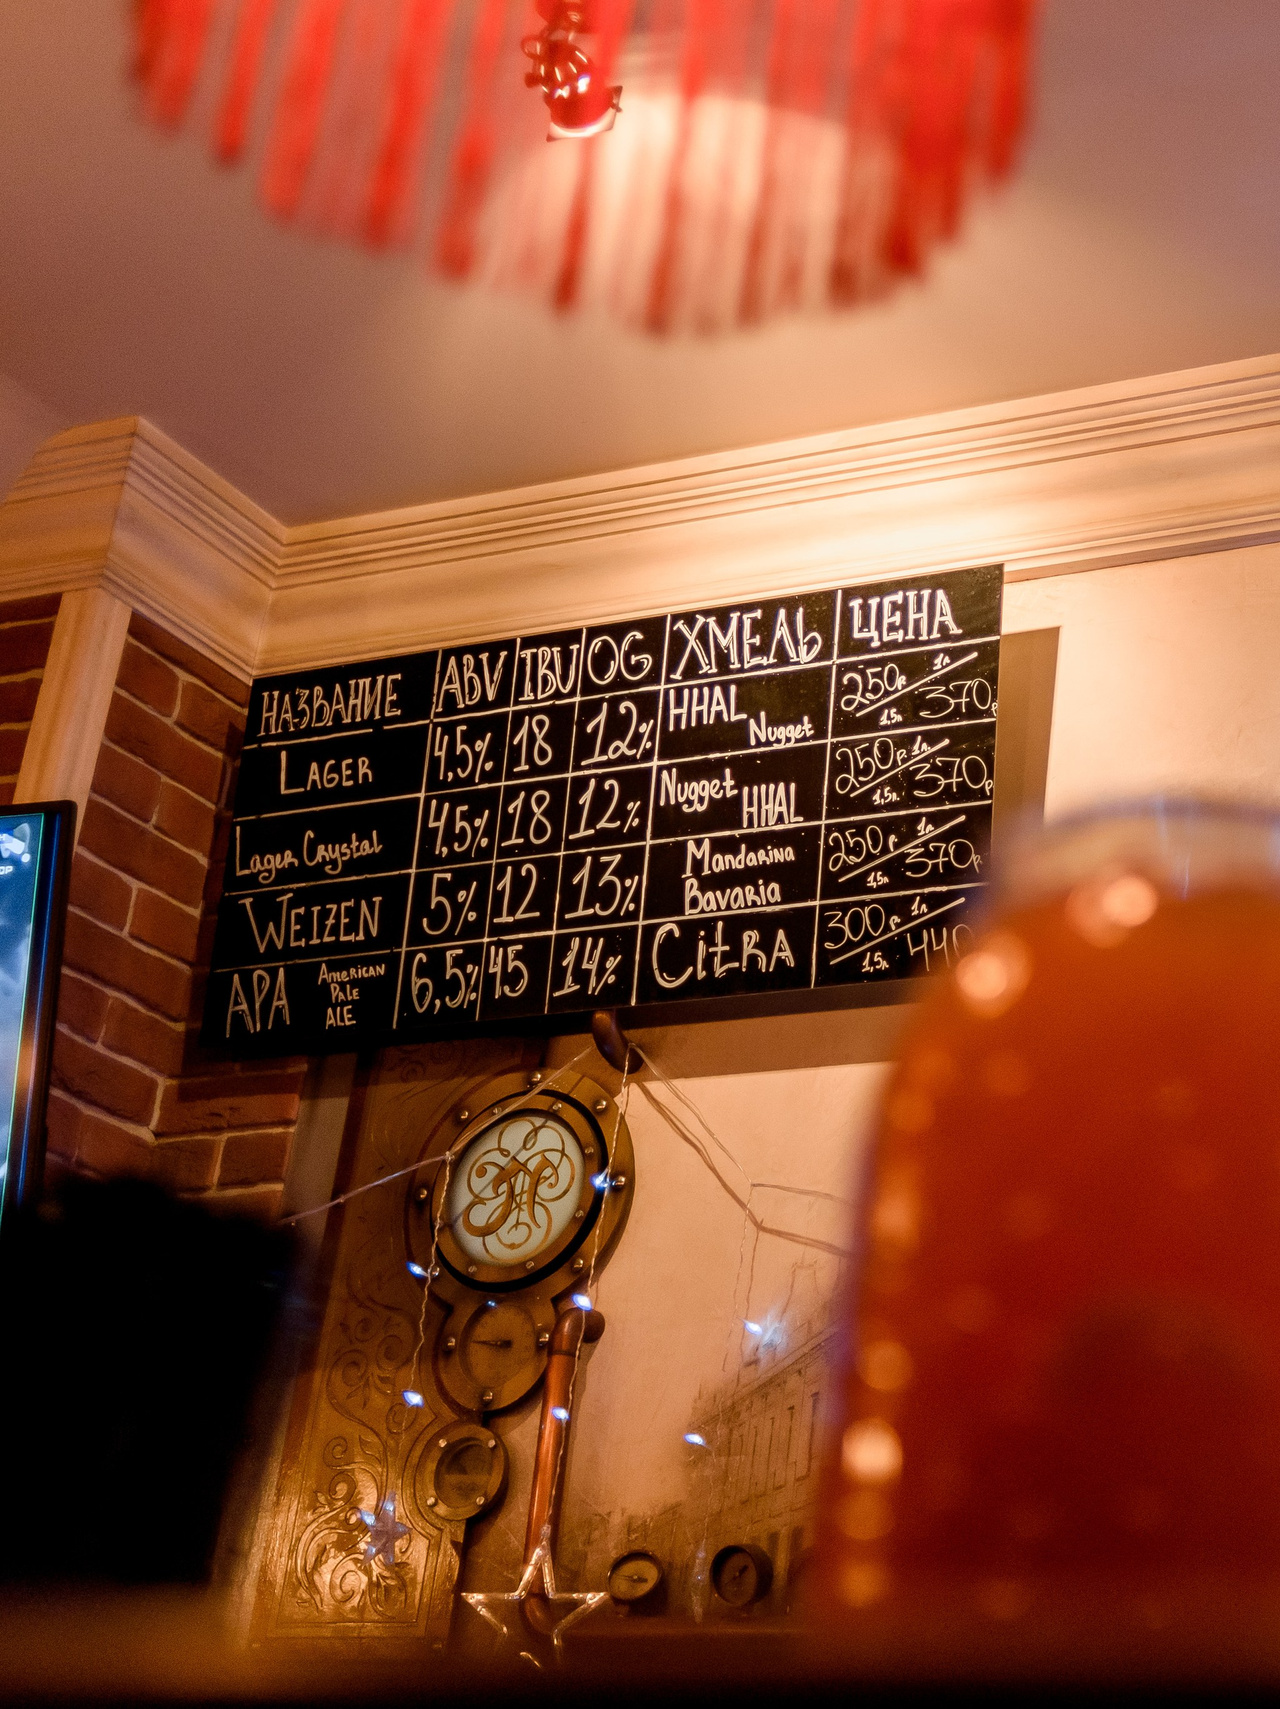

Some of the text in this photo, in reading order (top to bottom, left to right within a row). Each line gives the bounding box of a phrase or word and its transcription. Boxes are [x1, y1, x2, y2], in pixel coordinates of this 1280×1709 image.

[669, 606, 822, 680] ХМЕЛЬ
[849, 588, 963, 648] ЦЕНА
[435, 650, 508, 712] ABV
[518, 643, 581, 701] IBU
[586, 631, 653, 685] OG
[256, 673, 403, 737] НАЗВАНИЕ
[580, 700, 655, 766] 12%
[749, 712, 814, 748] Nugget
[512, 713, 553, 773] 18
[502, 789, 552, 847] 18
[568, 778, 640, 840] 12%
[659, 767, 738, 812] Nugget
[422, 872, 478, 936] 5%
[493, 862, 541, 924] 12
[564, 853, 639, 920] 13%
[489, 944, 529, 999] 45
[552, 937, 622, 998] 14%
[226, 966, 291, 1038] APA
